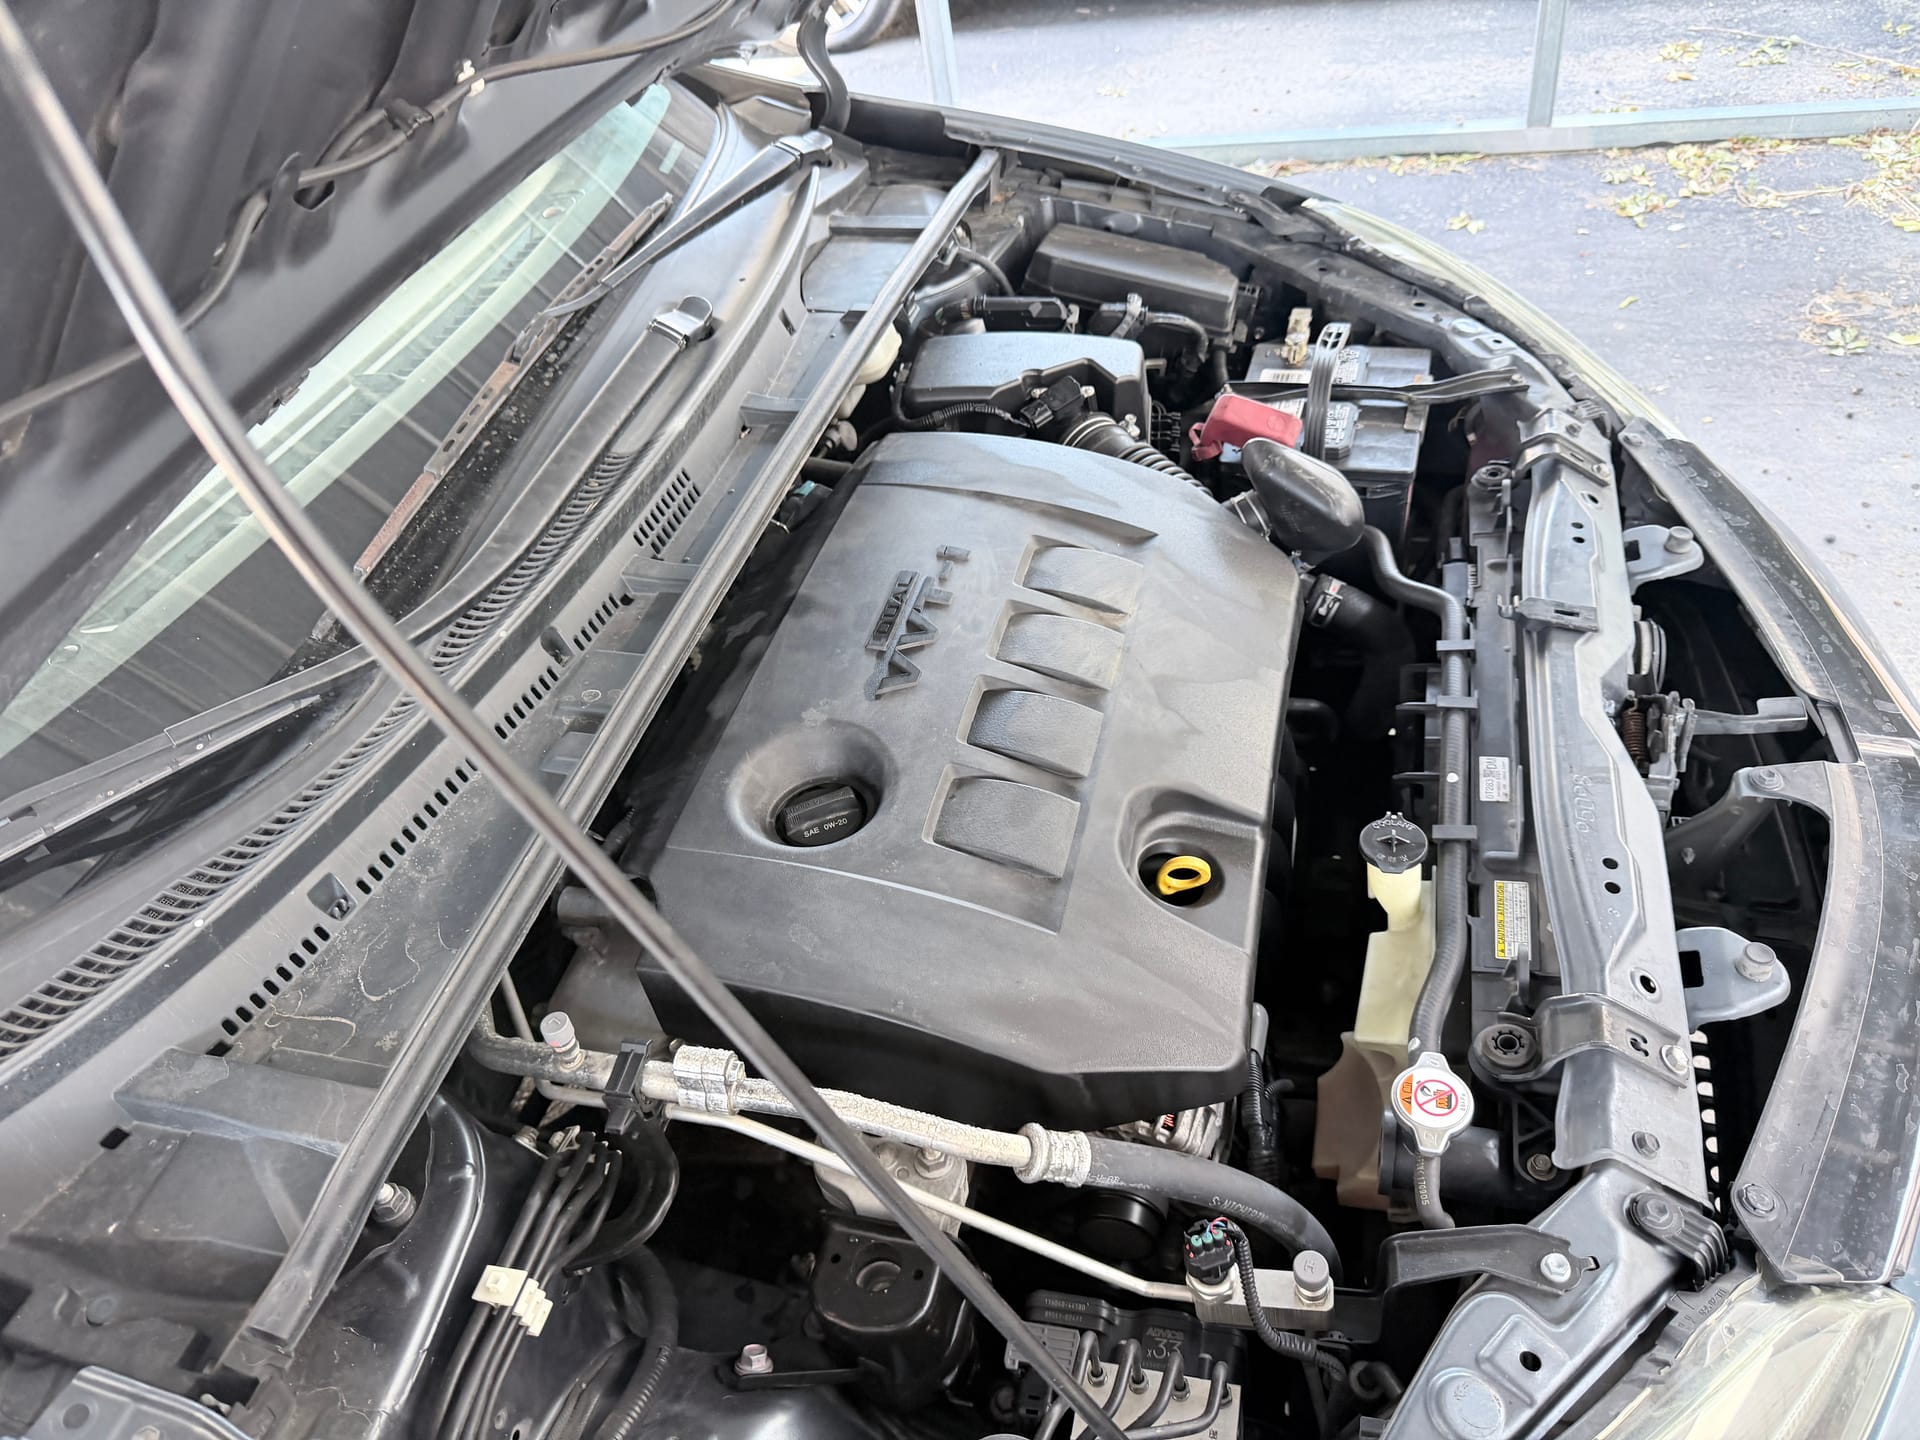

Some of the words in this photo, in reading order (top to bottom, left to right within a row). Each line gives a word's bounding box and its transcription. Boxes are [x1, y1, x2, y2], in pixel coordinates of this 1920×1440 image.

[872, 574, 914, 640] DUAL
[803, 827, 820, 838] SAE
[824, 818, 848, 831] 0W-20
[1371, 819, 1417, 831] COOLANT
